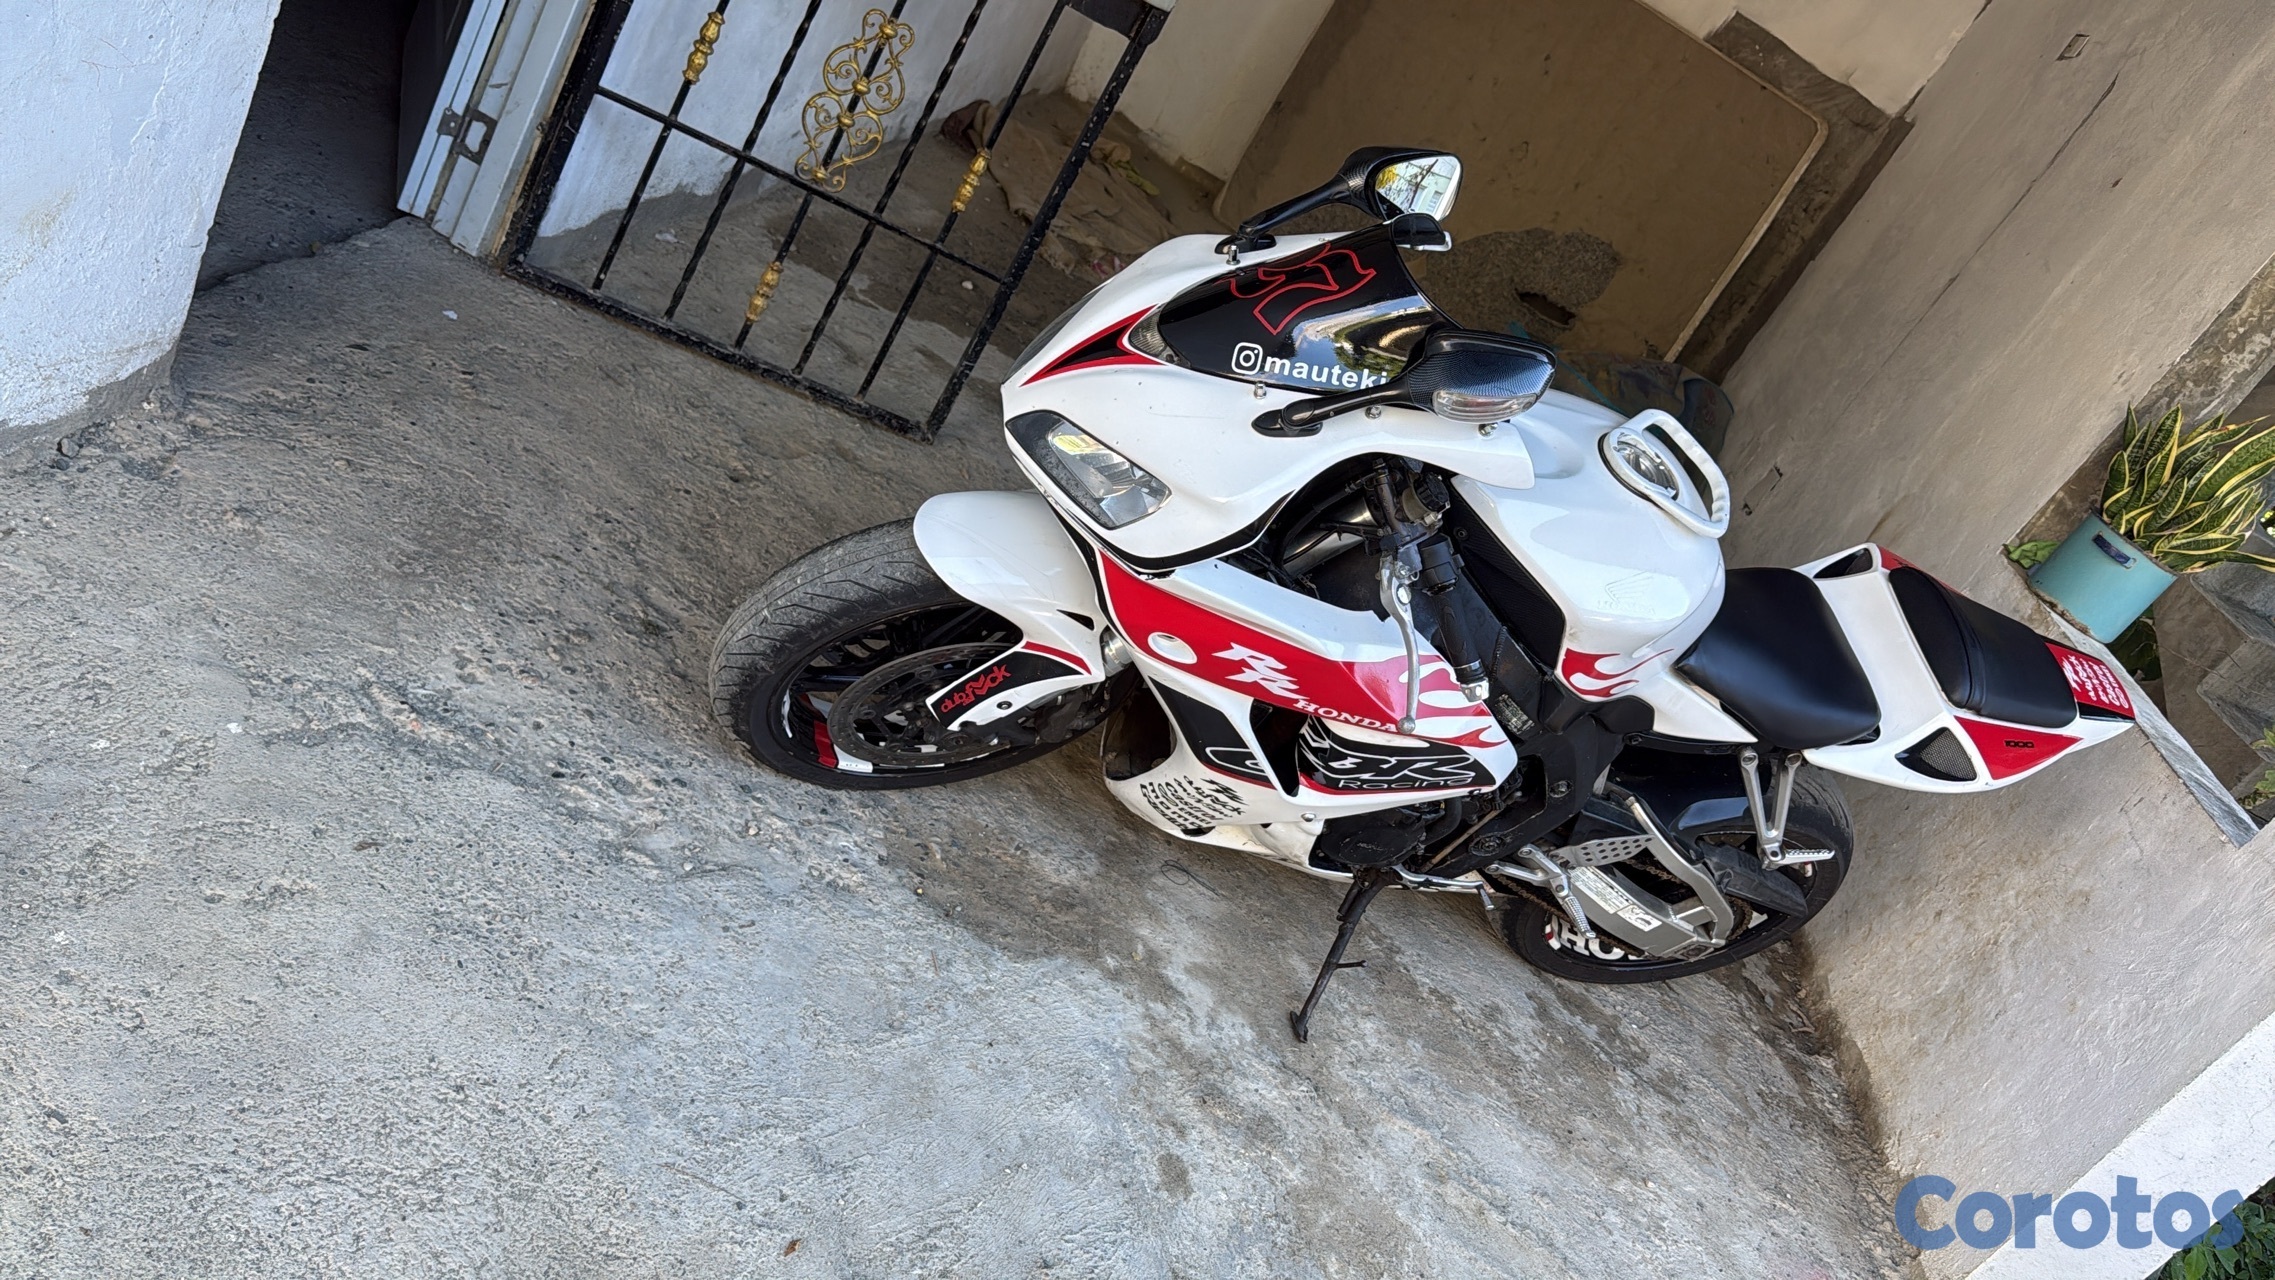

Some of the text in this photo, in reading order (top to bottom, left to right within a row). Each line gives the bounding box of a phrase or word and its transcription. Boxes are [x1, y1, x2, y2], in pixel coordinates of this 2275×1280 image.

[1293, 698, 1398, 732] HONDA
[2003, 739, 2035, 749] 1000
[1338, 776, 1473, 789] Racing
[1165, 781, 1225, 820] Castrol
